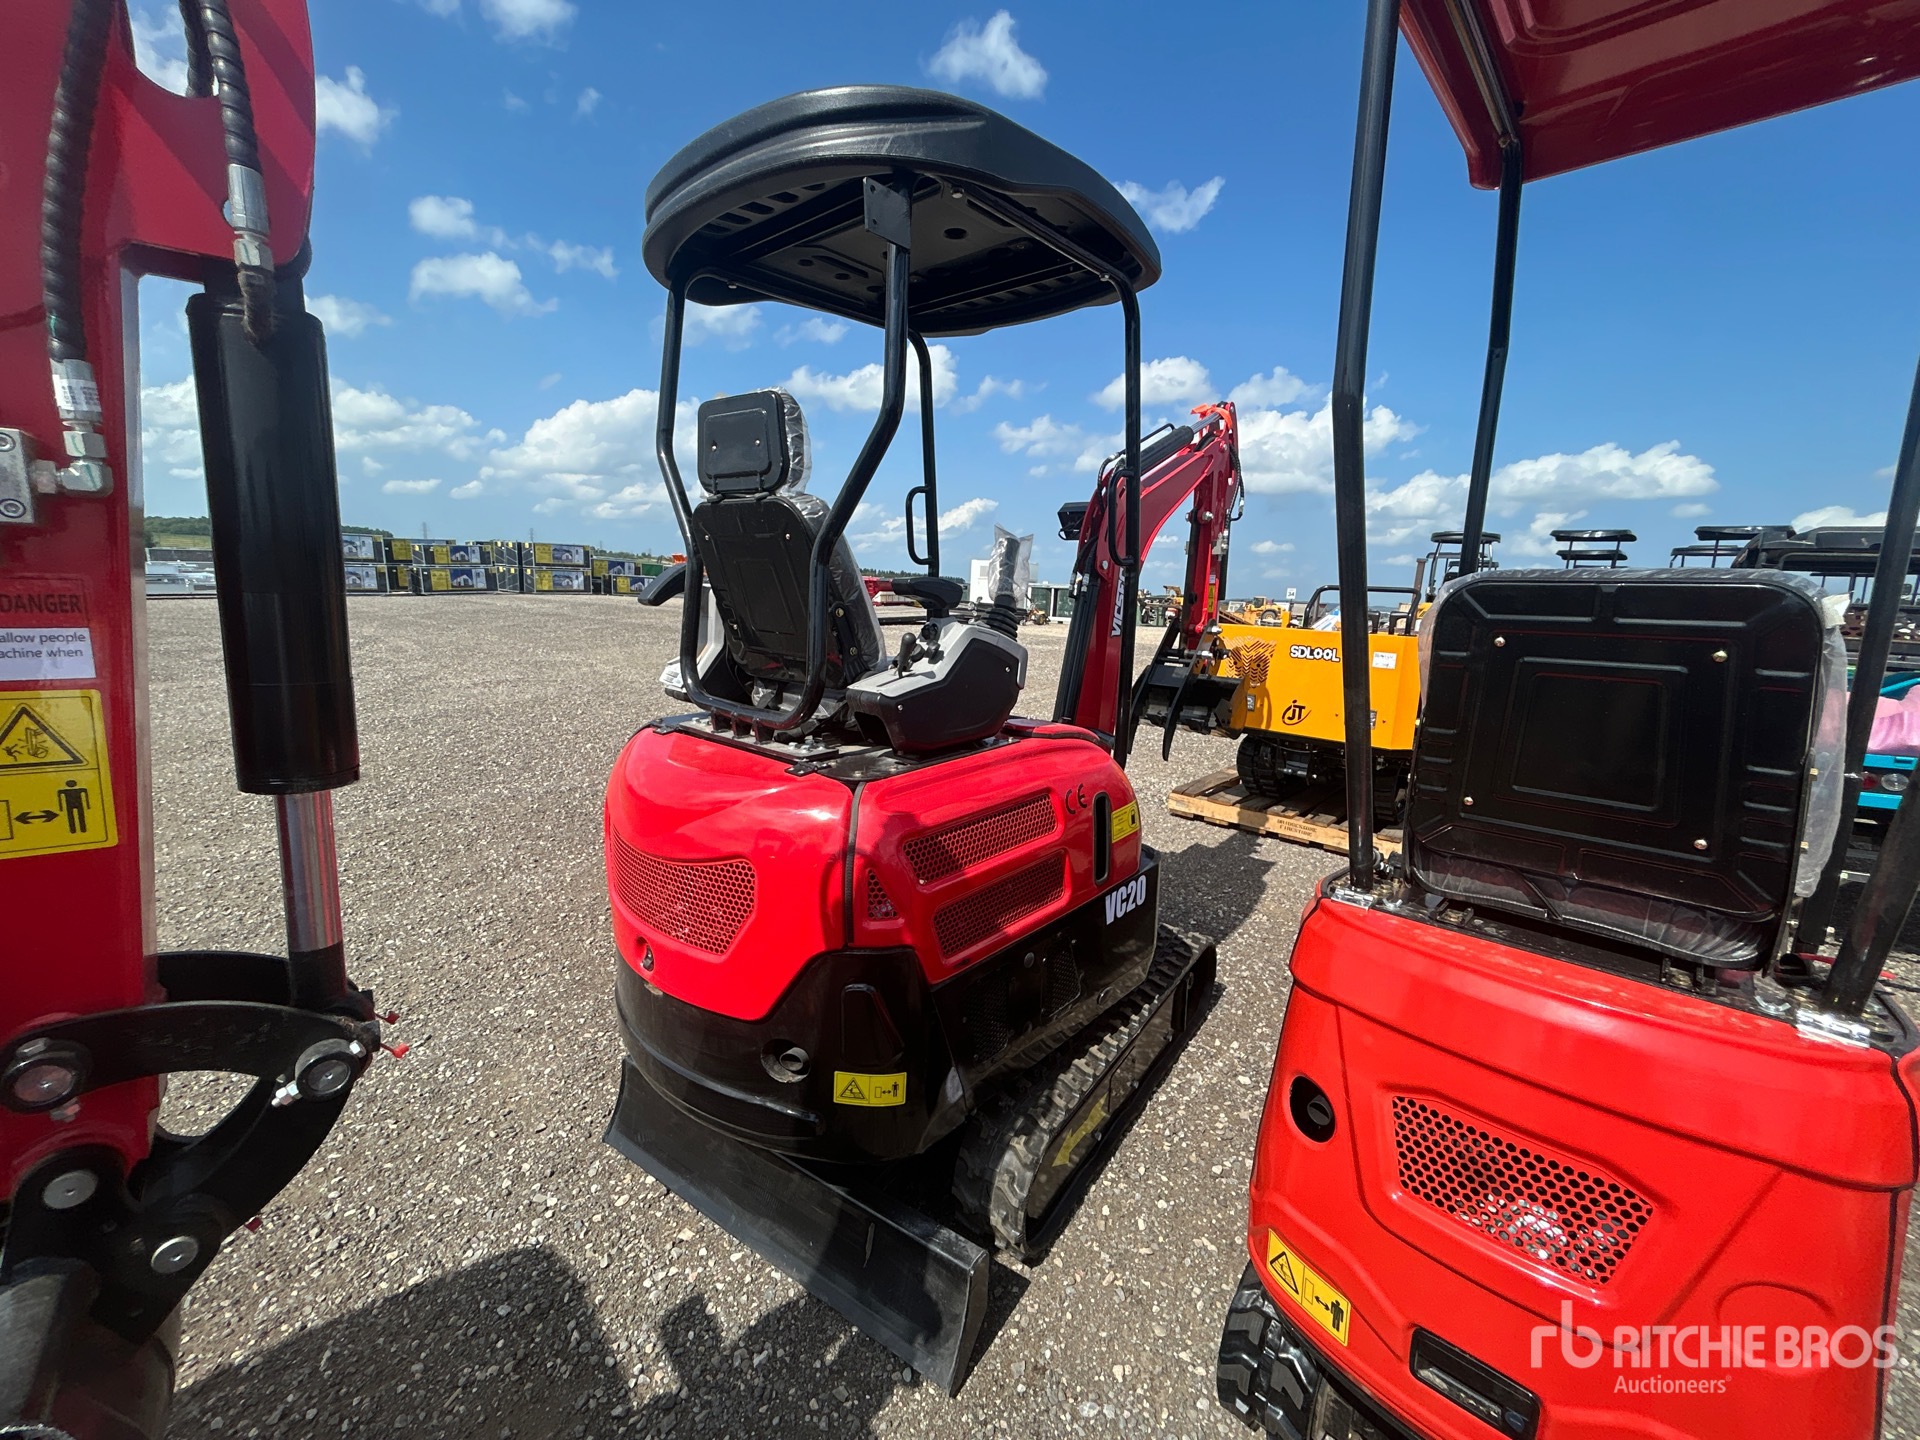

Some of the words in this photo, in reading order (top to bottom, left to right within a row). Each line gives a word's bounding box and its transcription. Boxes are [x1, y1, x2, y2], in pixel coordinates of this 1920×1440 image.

[0, 593, 82, 614] DANGER
[0, 632, 35, 643] allow
[39, 632, 86, 645] people
[46, 648, 84, 657] when
[1289, 645, 1341, 662] SDLOOL
[1104, 874, 1147, 926] VC20
